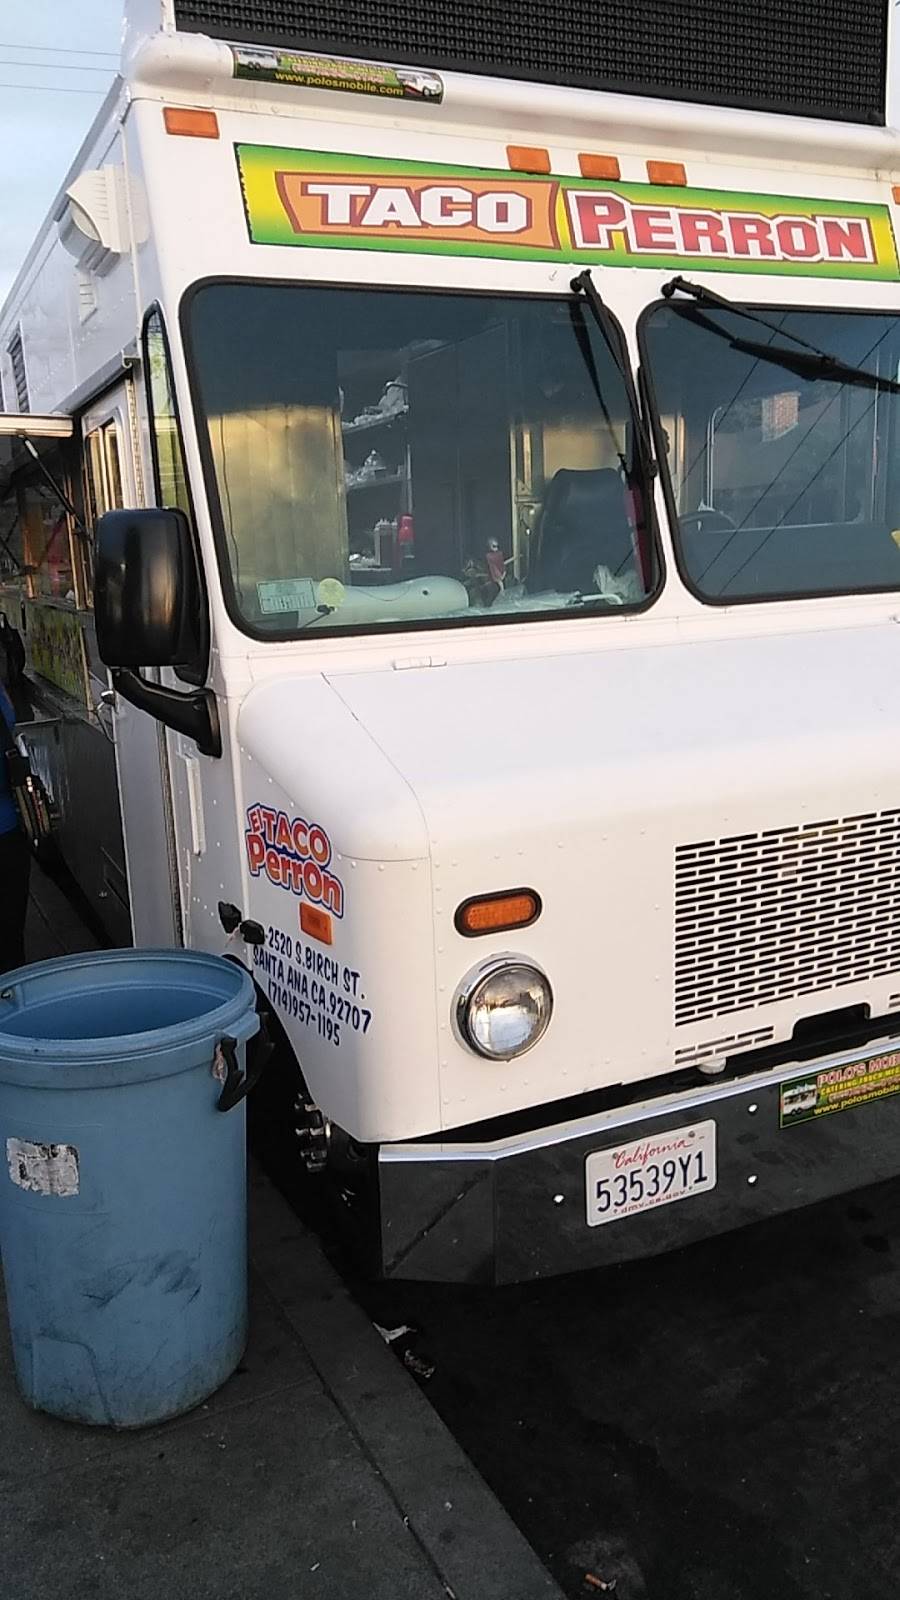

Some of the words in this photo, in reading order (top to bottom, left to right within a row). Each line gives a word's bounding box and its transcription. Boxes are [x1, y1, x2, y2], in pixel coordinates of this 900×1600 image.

[275, 71, 404, 96] www.polosmobile.com
[303, 182, 531, 233] TACO
[566, 190, 876, 264] PERRON
[261, 809, 330, 865] TACO
[253, 944, 285, 984] SANTA
[287, 965, 309, 999] ANA
[343, 966, 366, 1000] ST.
[615, 1138, 693, 1169] California
[595, 1150, 708, 1213] 53539Y1
